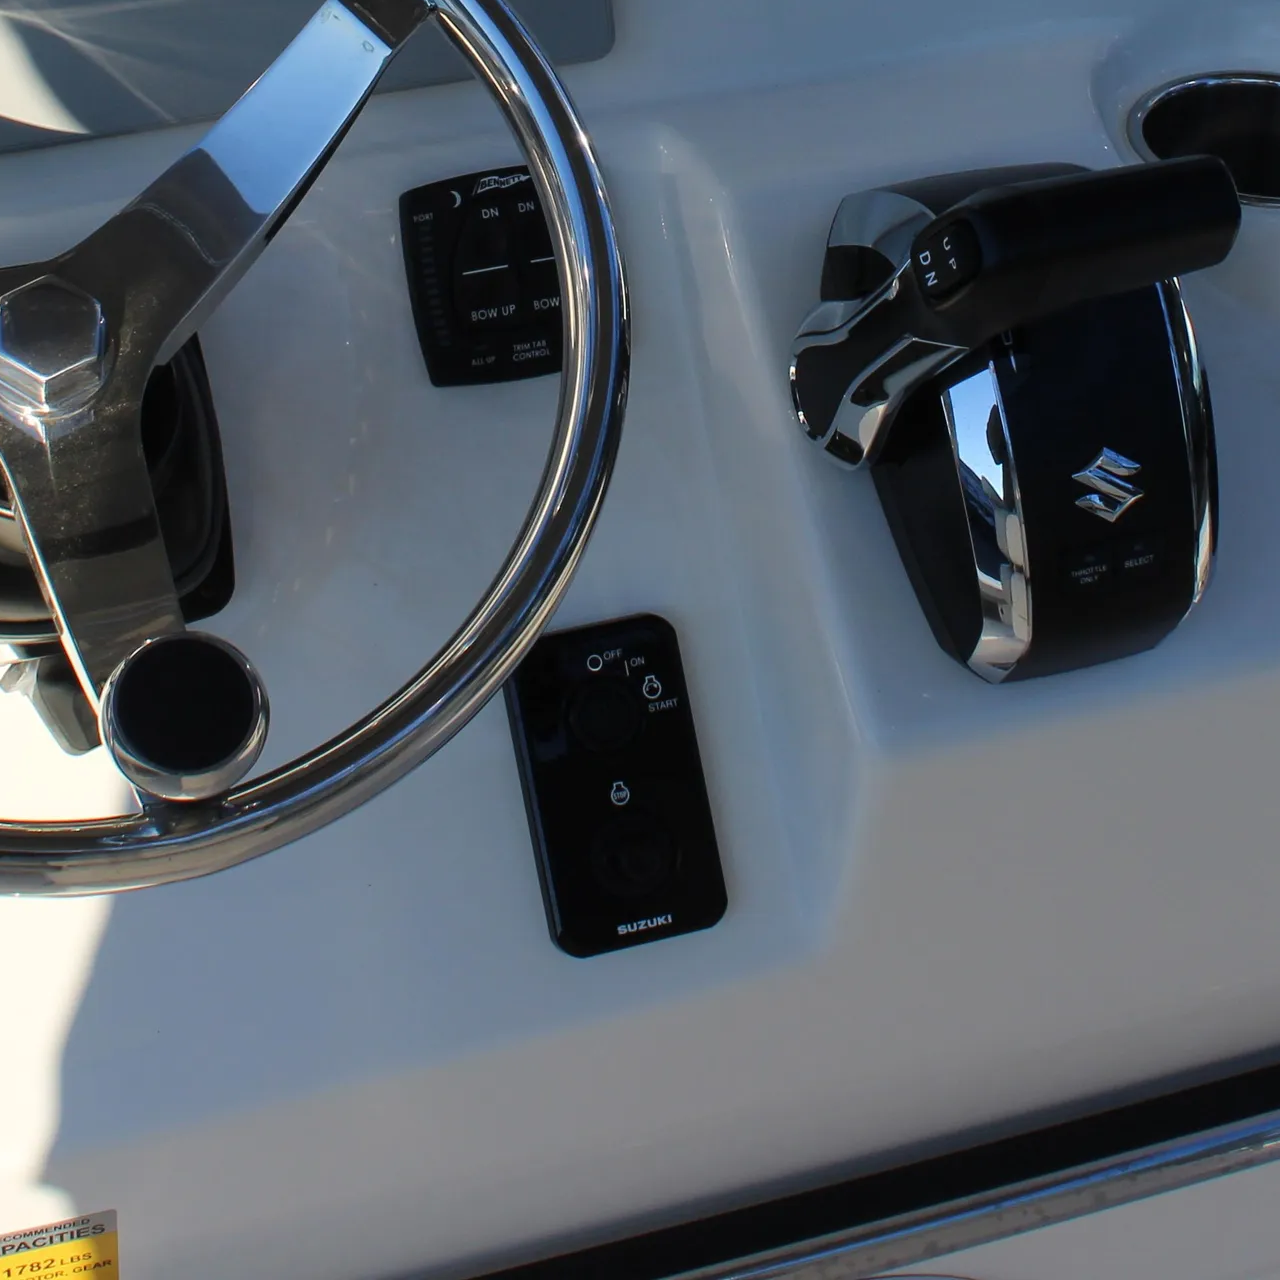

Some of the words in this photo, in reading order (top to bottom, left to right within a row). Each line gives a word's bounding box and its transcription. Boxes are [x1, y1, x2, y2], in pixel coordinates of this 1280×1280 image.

[481, 208, 500, 219] DN
[518, 201, 536, 213] DN
[533, 296, 560, 311] BOW
[471, 308, 498, 322] BOW
[501, 304, 516, 317] UP
[513, 343, 531, 352] TRIM
[532, 340, 547, 348] TAB
[512, 348, 551, 362] CONTROL
[1124, 554, 1155, 569] SELECT
[1071, 564, 1107, 578] THROTTLE
[1080, 575, 1099, 585] ONLY
[603, 648, 623, 661] OFF
[630, 656, 645, 668] ON
[648, 698, 679, 712] START
[617, 914, 673, 936] SUZUKI
[2, 1258, 57, 1278] 1782
[59, 1252, 93, 1266] LBS
[72, 1258, 112, 1273] GEAR
